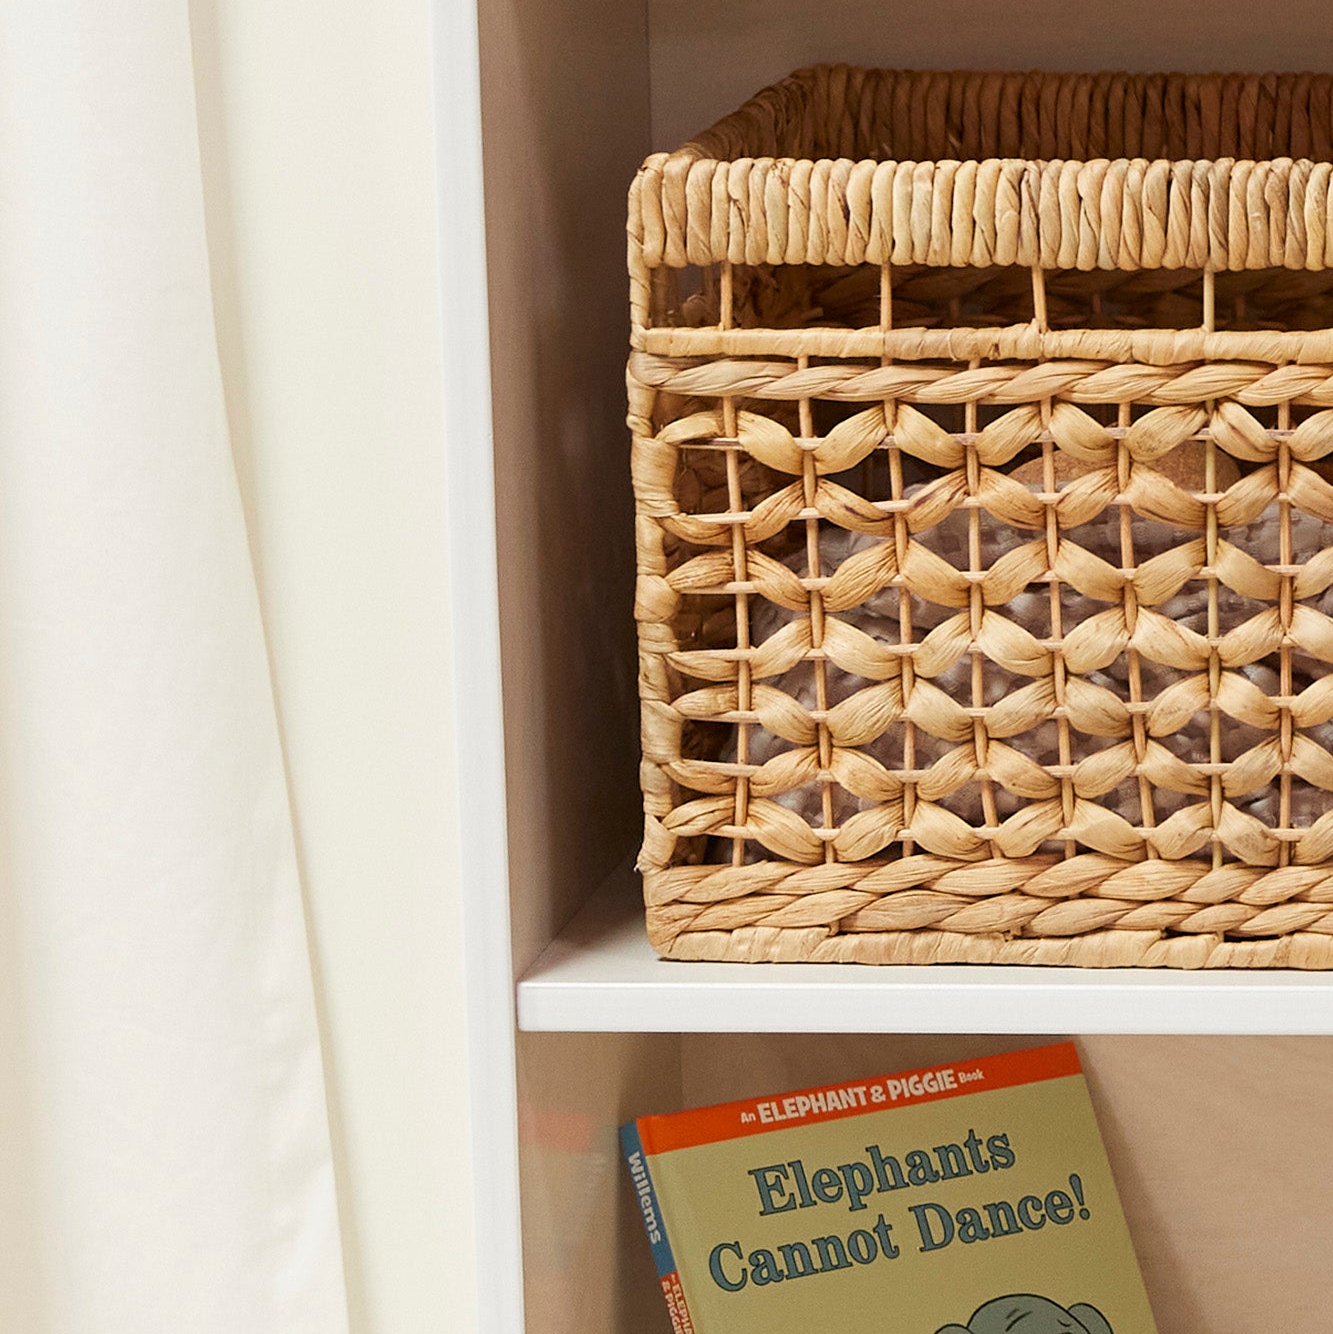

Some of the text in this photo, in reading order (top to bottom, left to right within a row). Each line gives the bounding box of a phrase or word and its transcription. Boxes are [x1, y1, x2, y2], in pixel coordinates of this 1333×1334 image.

[740, 1068, 985, 1125] An ELEPHANT & PIGGIE Book
[627, 1150, 661, 1245] Willems
[748, 1128, 1017, 1217] Elephants
[708, 1173, 1092, 1292] Cannot Dance!
